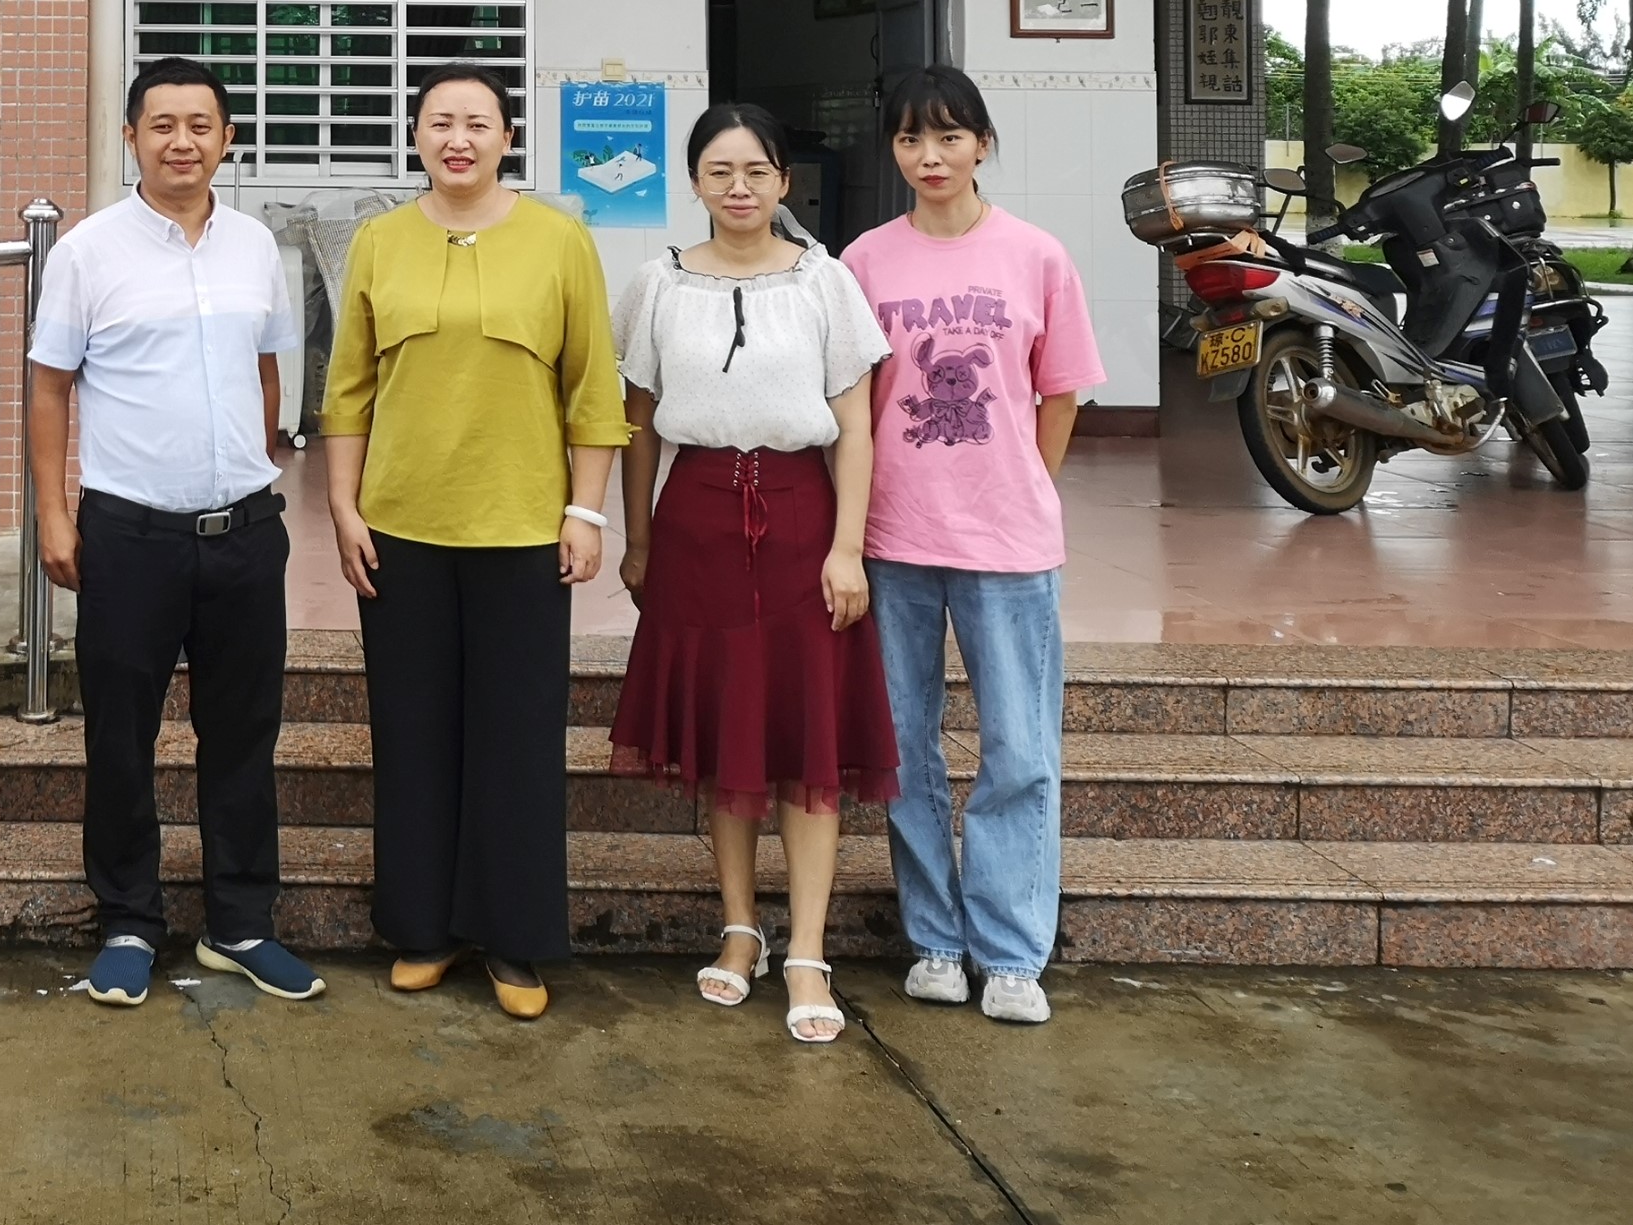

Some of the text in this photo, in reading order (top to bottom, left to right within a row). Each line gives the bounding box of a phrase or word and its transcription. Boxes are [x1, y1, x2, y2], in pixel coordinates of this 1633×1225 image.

[968, 285, 1003, 297] PRIVATE
[878, 294, 1013, 336] TRAVEL
[943, 327, 1005, 340] TAKE A DAY OFF
[1201, 342, 1252, 376] KZ580
